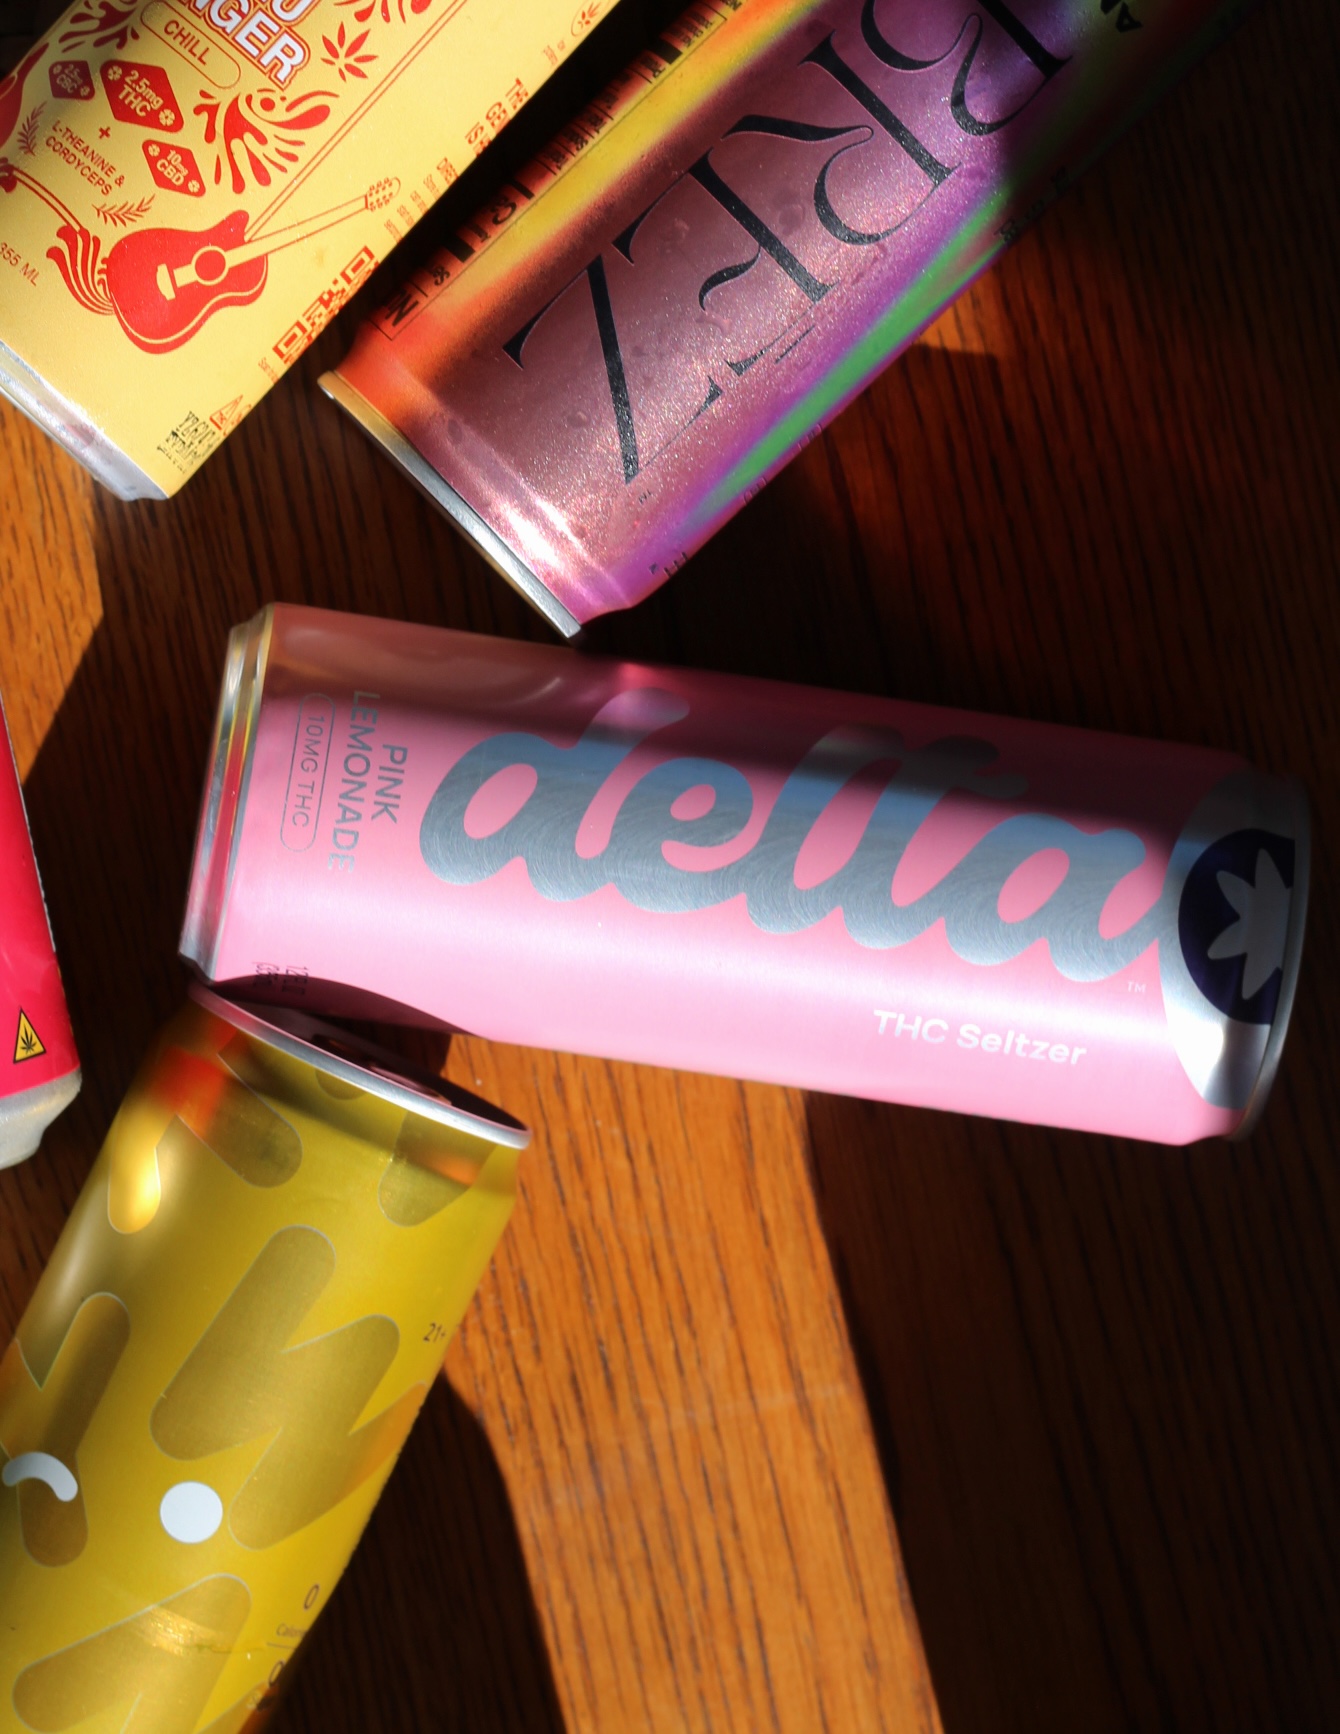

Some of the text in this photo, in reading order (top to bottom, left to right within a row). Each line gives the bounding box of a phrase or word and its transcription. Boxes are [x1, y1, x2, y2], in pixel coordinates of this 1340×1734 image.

[163, 18, 210, 66] CHILL
[195, 0, 309, 86] GER
[118, 84, 152, 117] THC
[124, 69, 164, 111] 2.5mg
[45, 135, 113, 196] CORDYCEPS
[51, 119, 125, 188] L-THEANINE &
[156, 158, 185, 186] CBD
[20, 262, 40, 287] ML
[292, 714, 326, 828] 10MG THC
[327, 689, 381, 873] LEMONADE
[371, 743, 409, 825] PINK
[419, 685, 1165, 984] delta
[872, 1008, 1088, 1067] THC Seltzer
